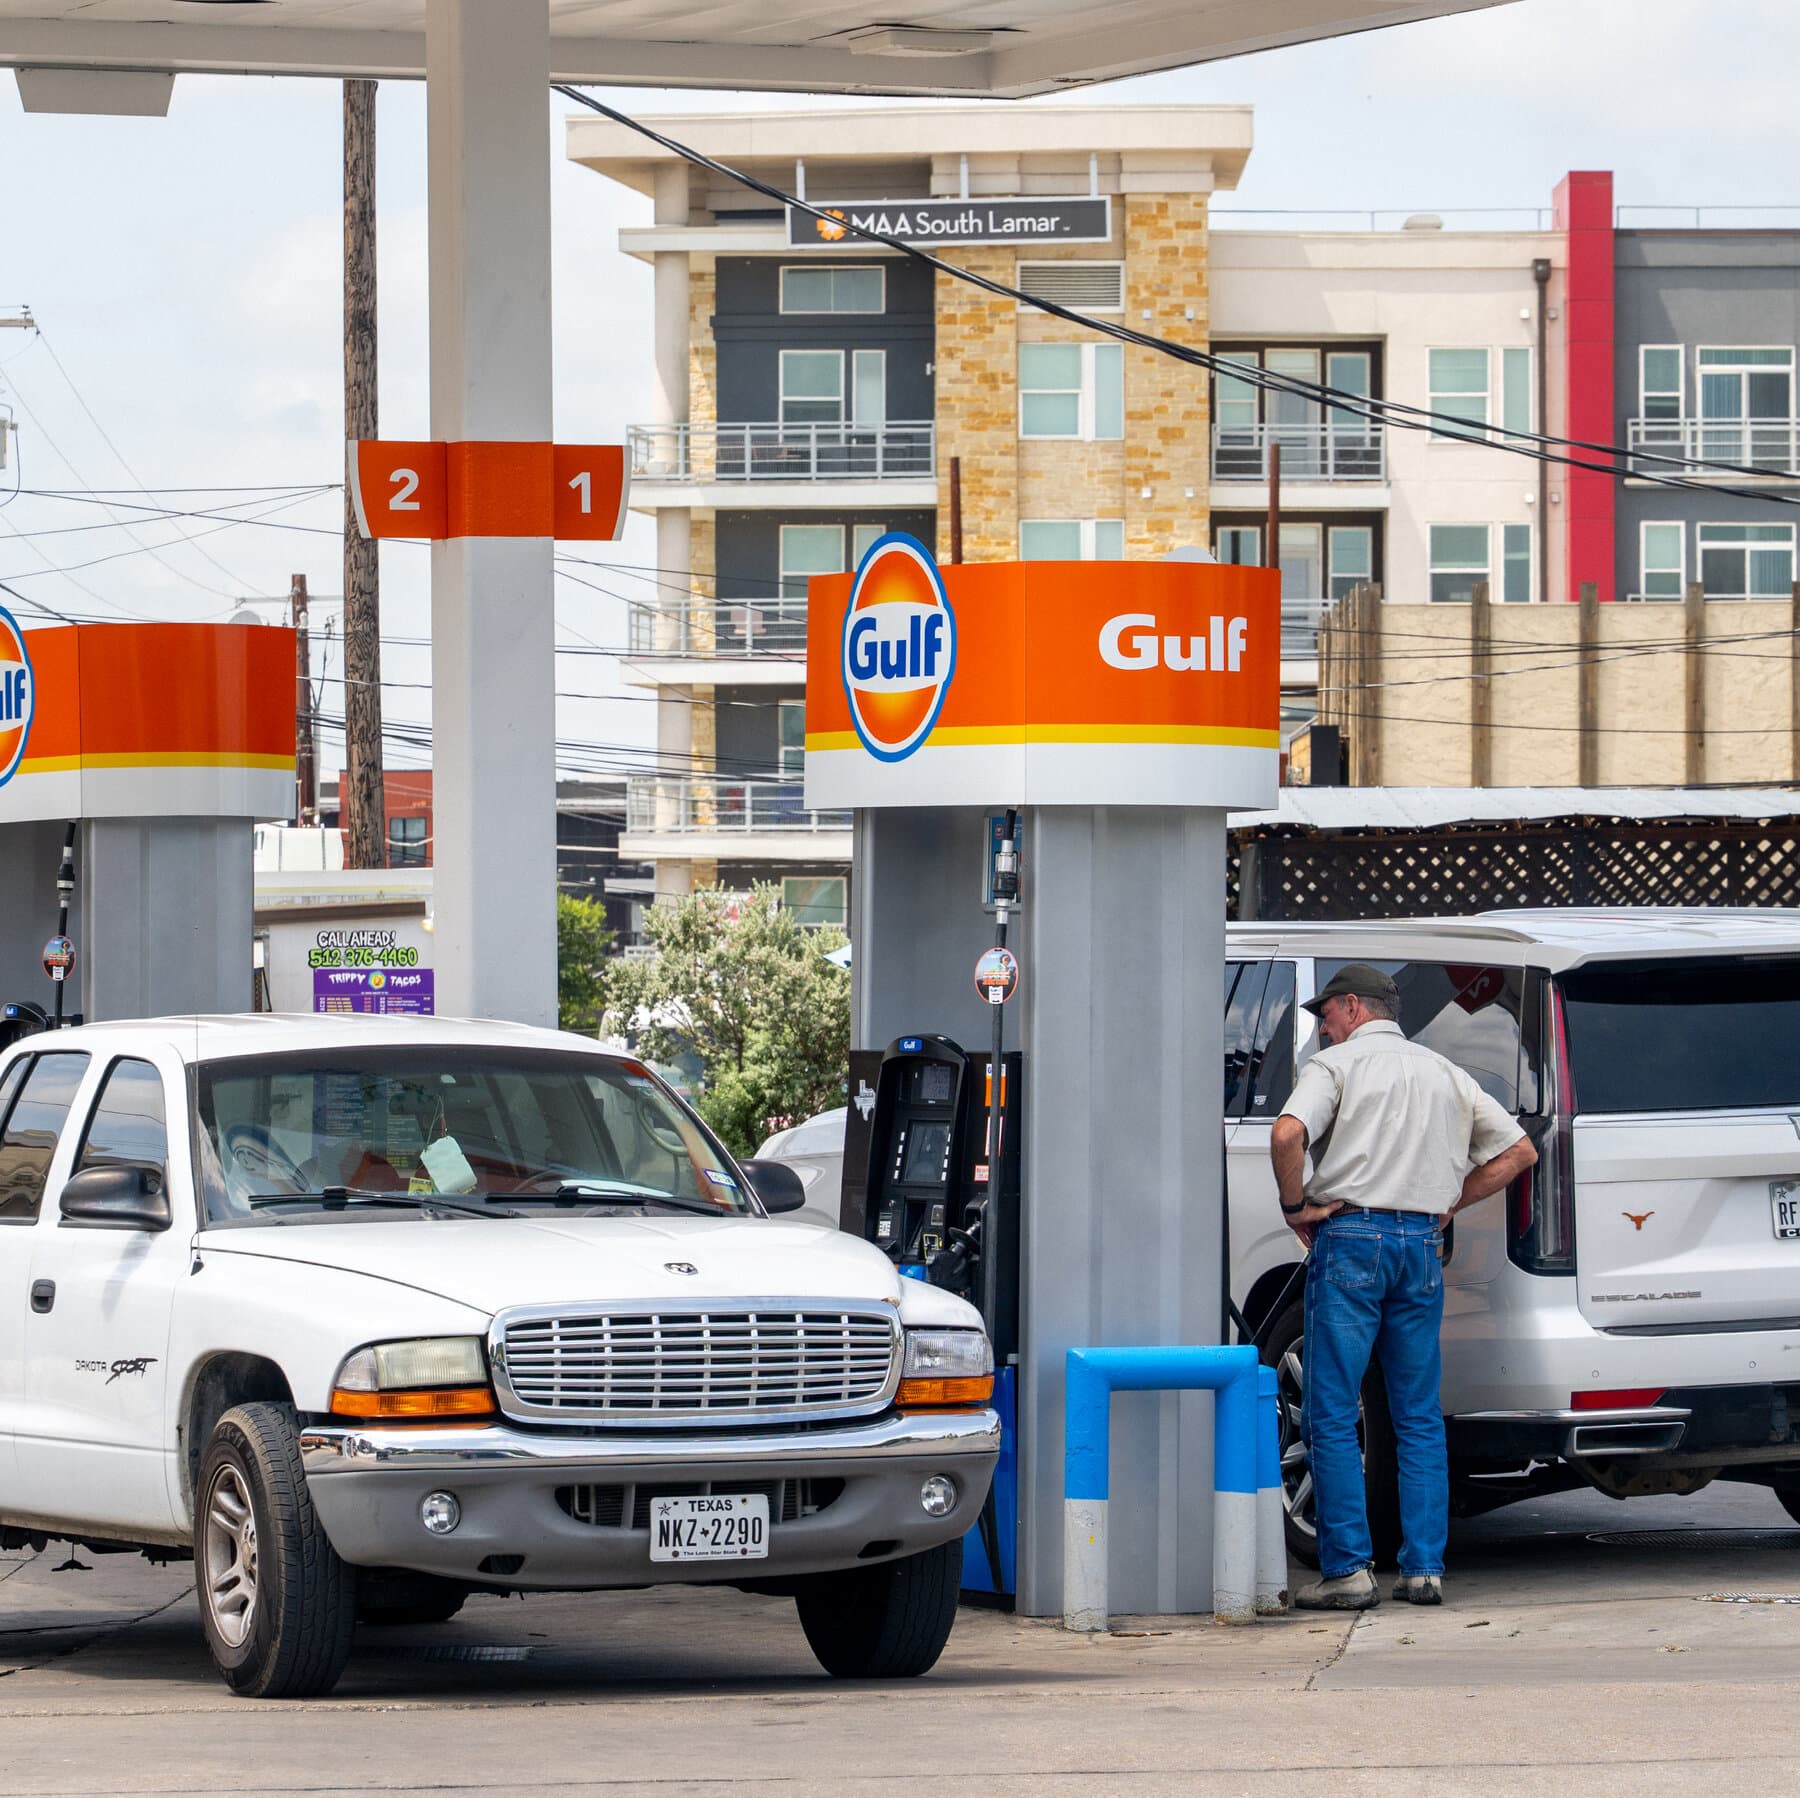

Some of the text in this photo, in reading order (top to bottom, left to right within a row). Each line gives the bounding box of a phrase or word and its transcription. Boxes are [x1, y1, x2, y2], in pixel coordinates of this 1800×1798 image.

[851, 210, 1061, 236] MAA South Lamar
[388, 468, 420, 511] 2
[568, 471, 592, 514] 1
[848, 613, 943, 681] Gulf
[1098, 613, 1248, 672] Gulf
[0, 668, 26, 720] lf
[317, 930, 397, 948] CALL AHEAD!
[329, 972, 421, 988] TRIPPY TACOS
[1778, 1201, 1798, 1225] RF
[1591, 1291, 1702, 1303] ESCALADE
[75, 1357, 159, 1386] DAKOTA SPORT
[688, 1499, 733, 1513] TEXAS
[658, 1516, 763, 1548] NKZ 2290
